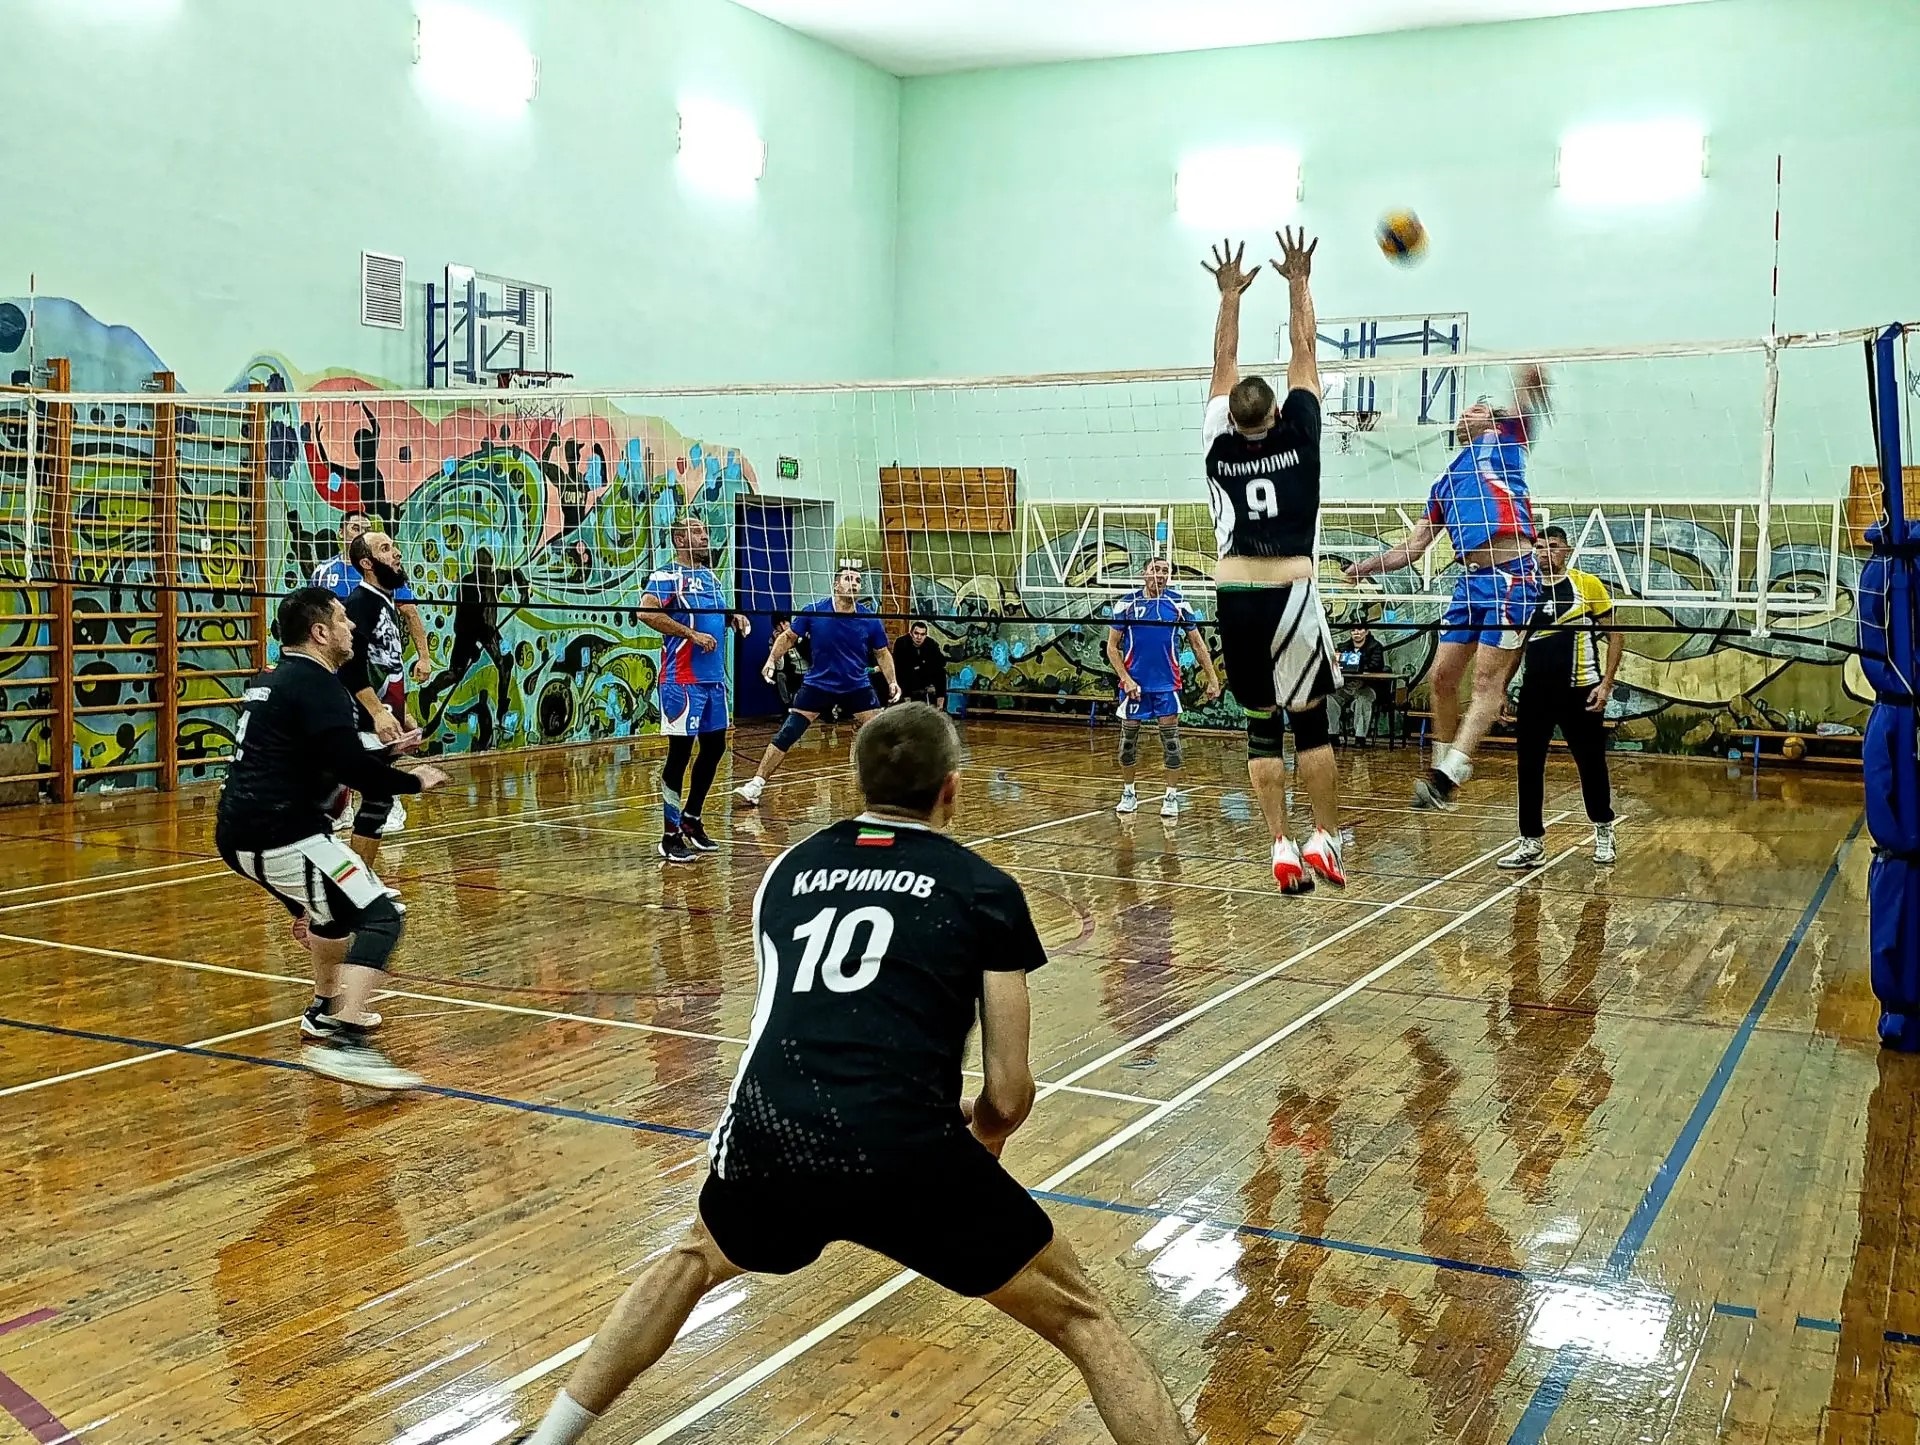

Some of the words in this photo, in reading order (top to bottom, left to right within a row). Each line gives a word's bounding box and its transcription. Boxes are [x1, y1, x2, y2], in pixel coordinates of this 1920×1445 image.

[1245, 478, 1279, 521] 9
[1032, 507, 1817, 600] VOLEYALL
[326, 573, 340, 587] 19
[1134, 606, 1147, 619] 17
[1129, 703, 1140, 714] 17
[791, 868, 937, 899] КАРИМОВ
[791, 905, 895, 994] 10
